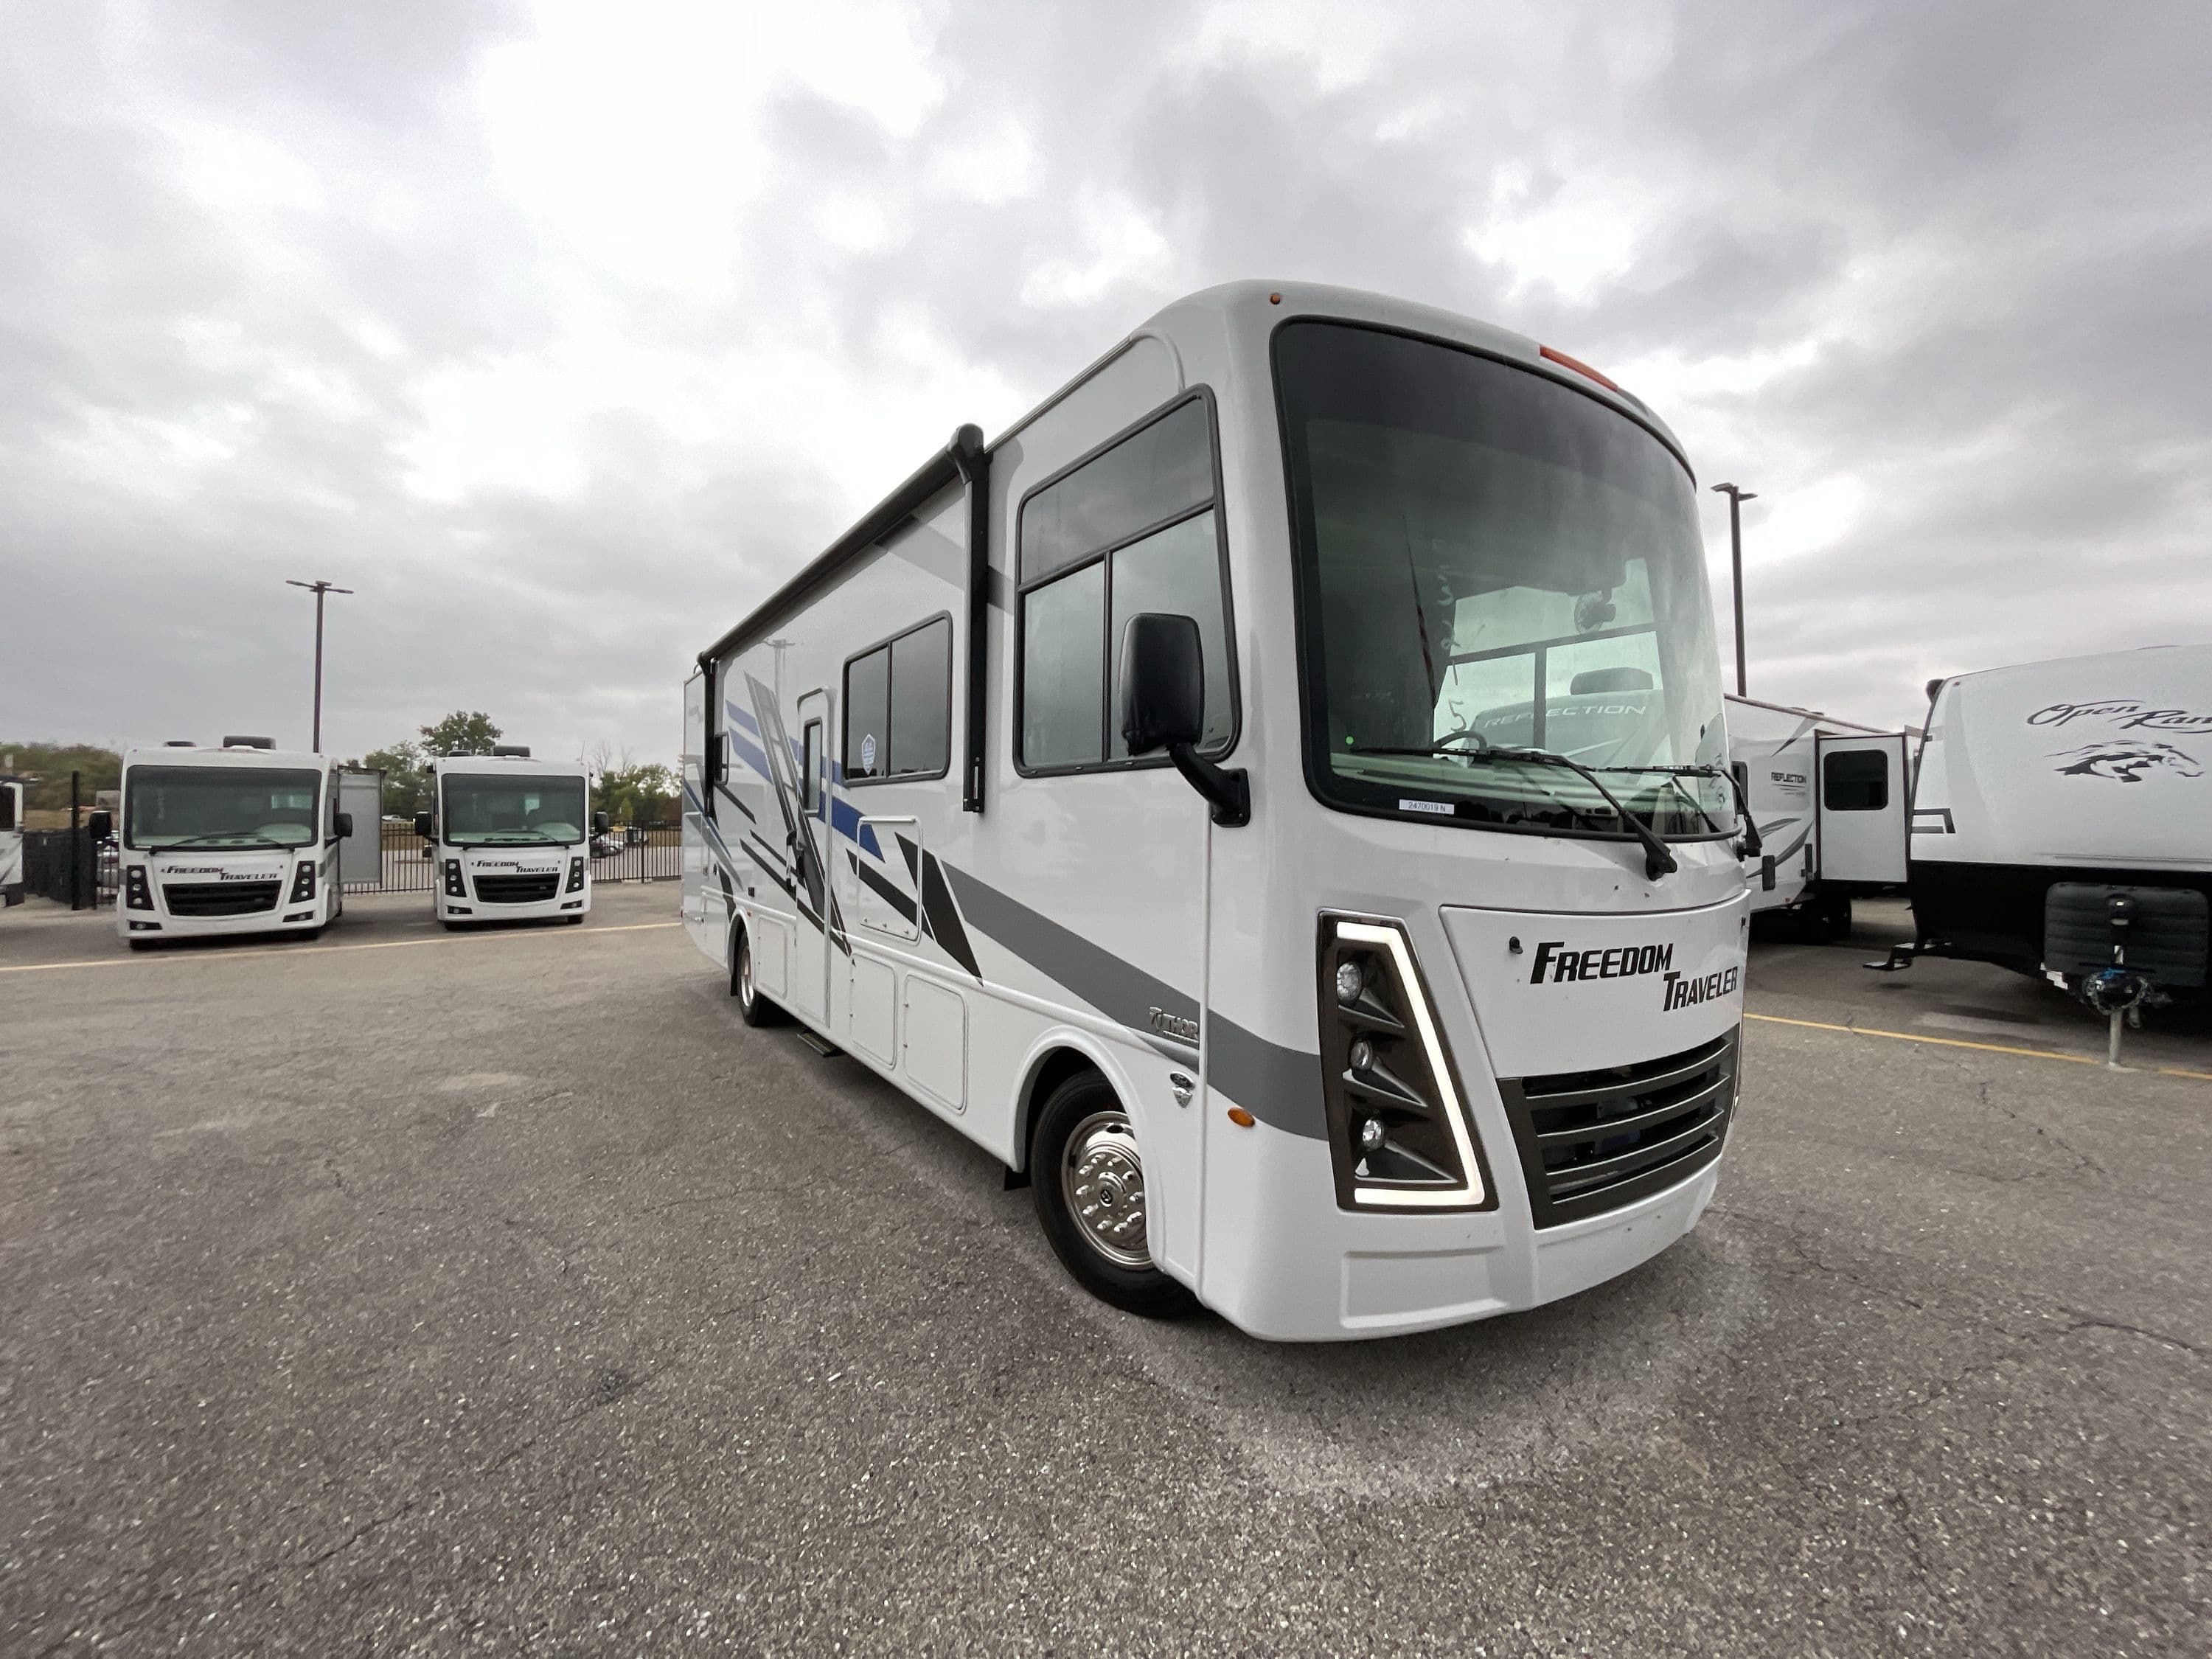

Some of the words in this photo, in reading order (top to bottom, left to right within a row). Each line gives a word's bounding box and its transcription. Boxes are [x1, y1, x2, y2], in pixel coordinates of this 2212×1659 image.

[2028, 700, 2144, 727] Open
[2107, 710, 2212, 734] Ran
[1771, 771, 1806, 784] REFLECTION
[1440, 804, 1446, 813] N
[167, 866, 224, 874] FREEDOM
[220, 872, 278, 880] TRAVELER
[1530, 942, 1673, 984] FREEDOM
[1663, 966, 1739, 1012] TRAVELER
[1163, 1013, 1199, 1040] THOR
